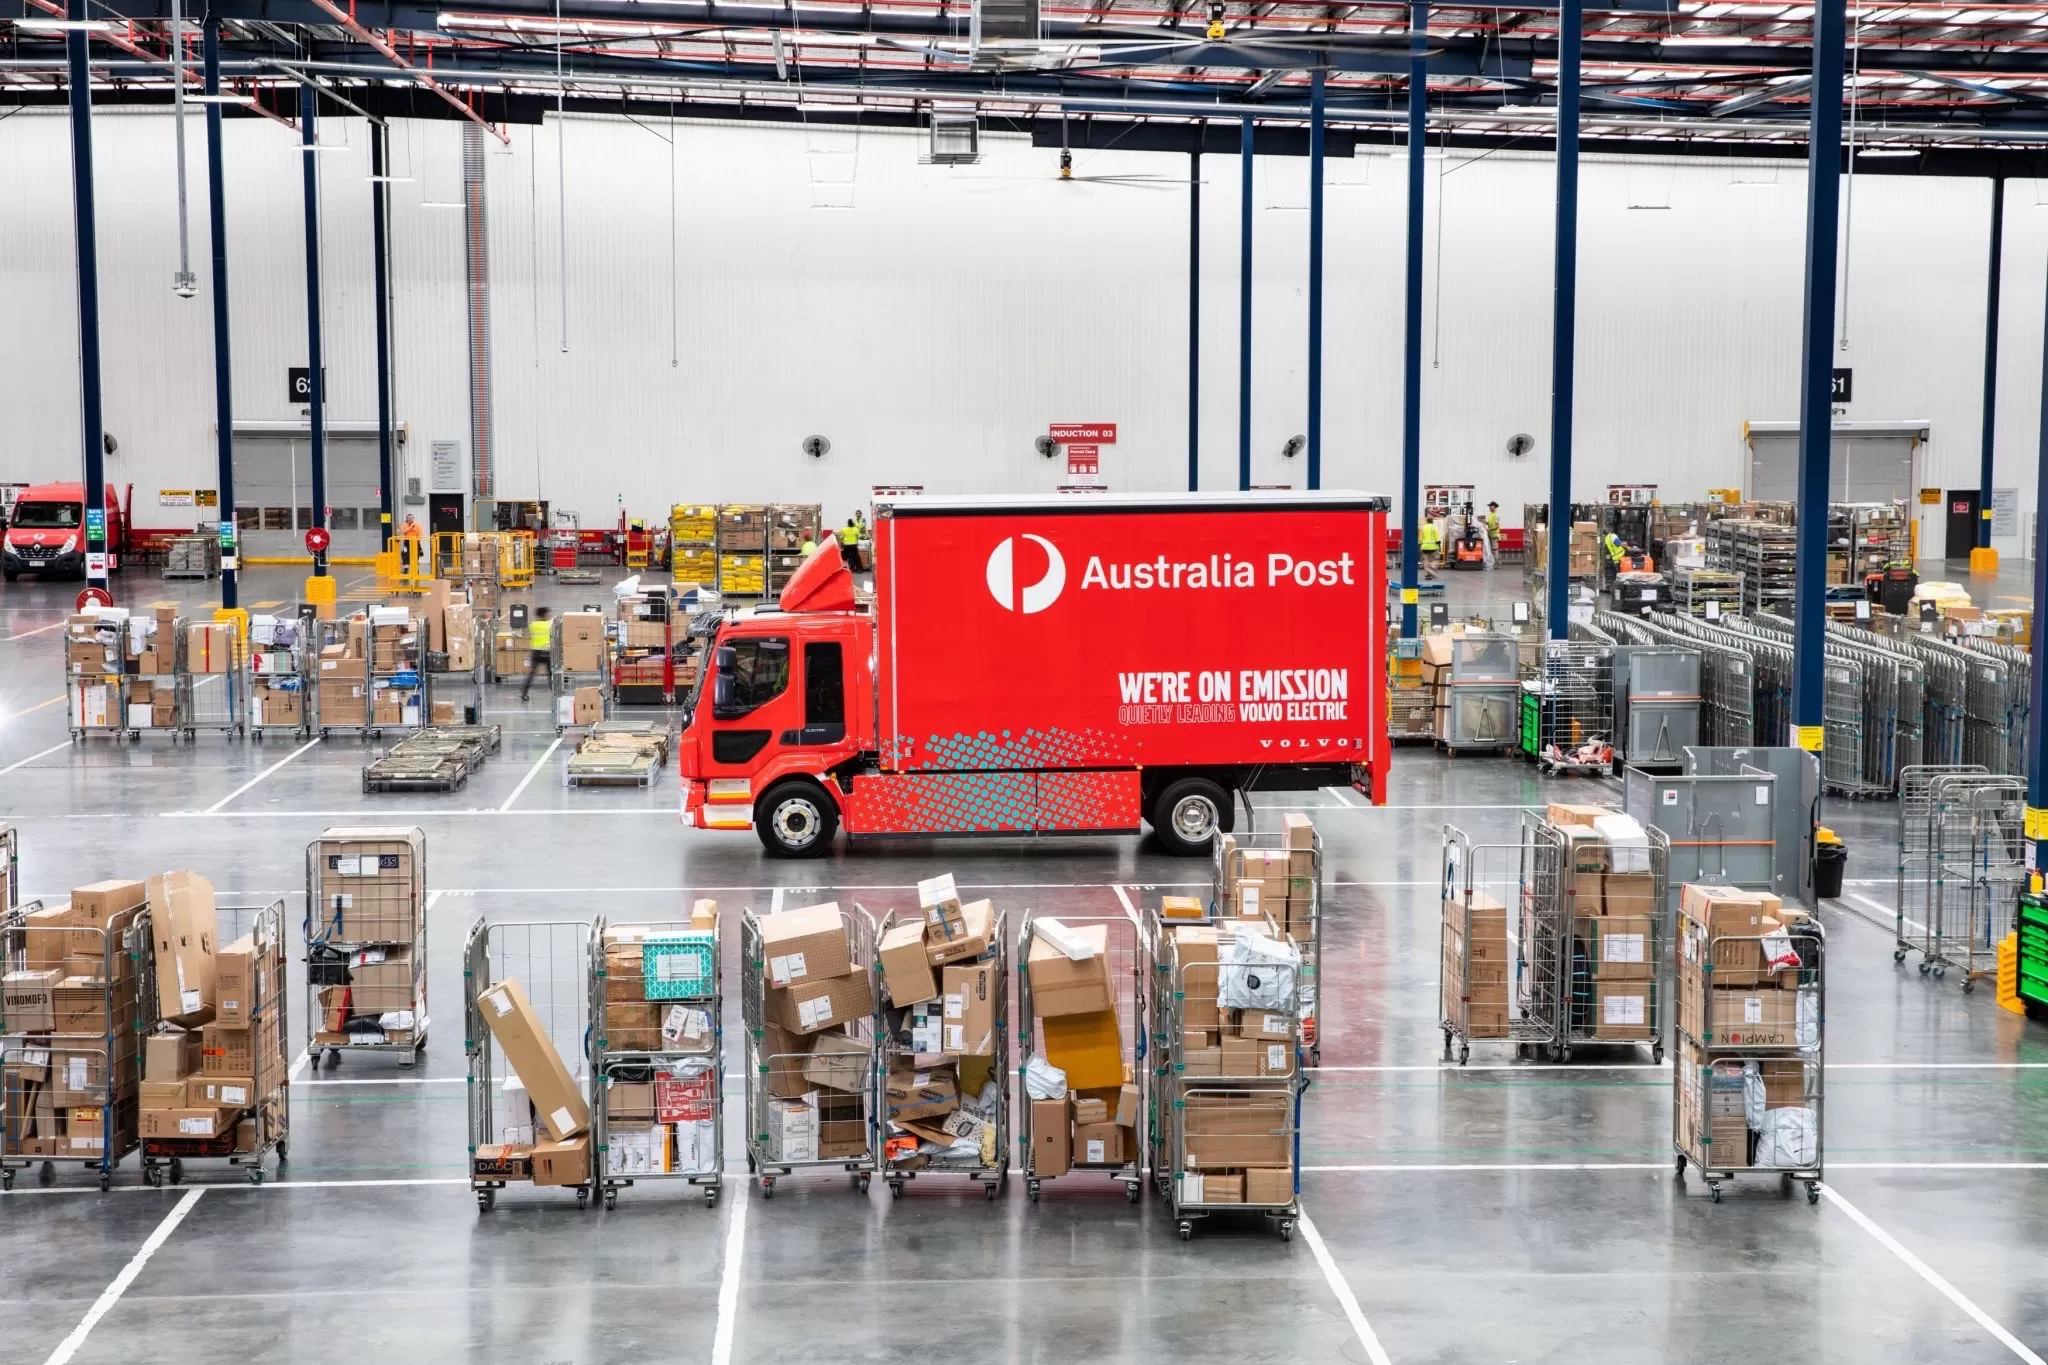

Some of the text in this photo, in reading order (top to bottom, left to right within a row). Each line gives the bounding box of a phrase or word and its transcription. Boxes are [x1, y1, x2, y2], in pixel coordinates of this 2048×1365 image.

[296, 377, 310, 393] 6
[1051, 429, 1098, 437] INDUCTION
[1081, 552, 1354, 590] Australia Post
[1119, 668, 1348, 704] WE'RE ON EMISSION
[1119, 701, 1348, 726] QUIETLY LEADING VOLVO ELECTRIC
[1259, 737, 1349, 749] VOLVO
[5, 993, 48, 1006] VINOMOFO
